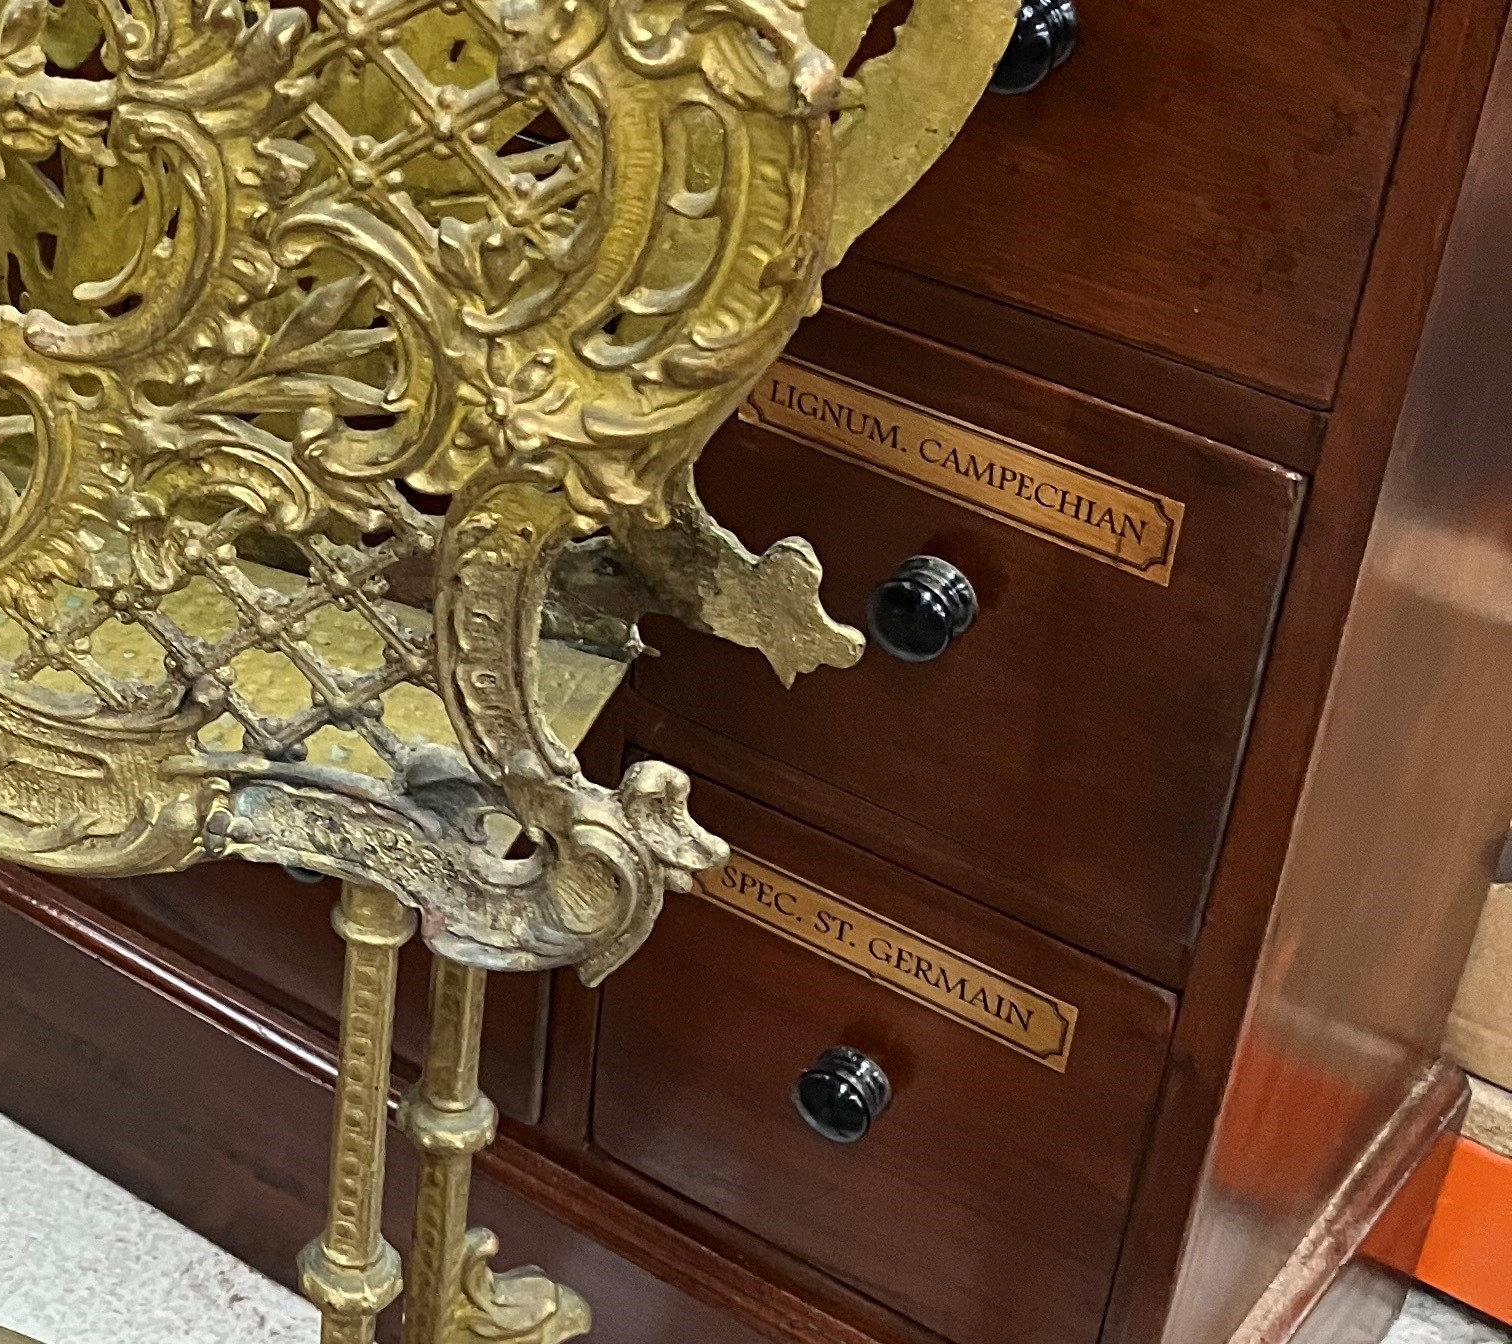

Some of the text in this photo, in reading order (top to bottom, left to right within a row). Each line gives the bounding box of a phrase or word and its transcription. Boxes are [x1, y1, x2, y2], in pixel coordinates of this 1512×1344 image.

[769, 379, 1150, 546] LIGNUM. CAMPECHIAN
[720, 866, 1035, 1033] SPEC. ST. GERMAIN
